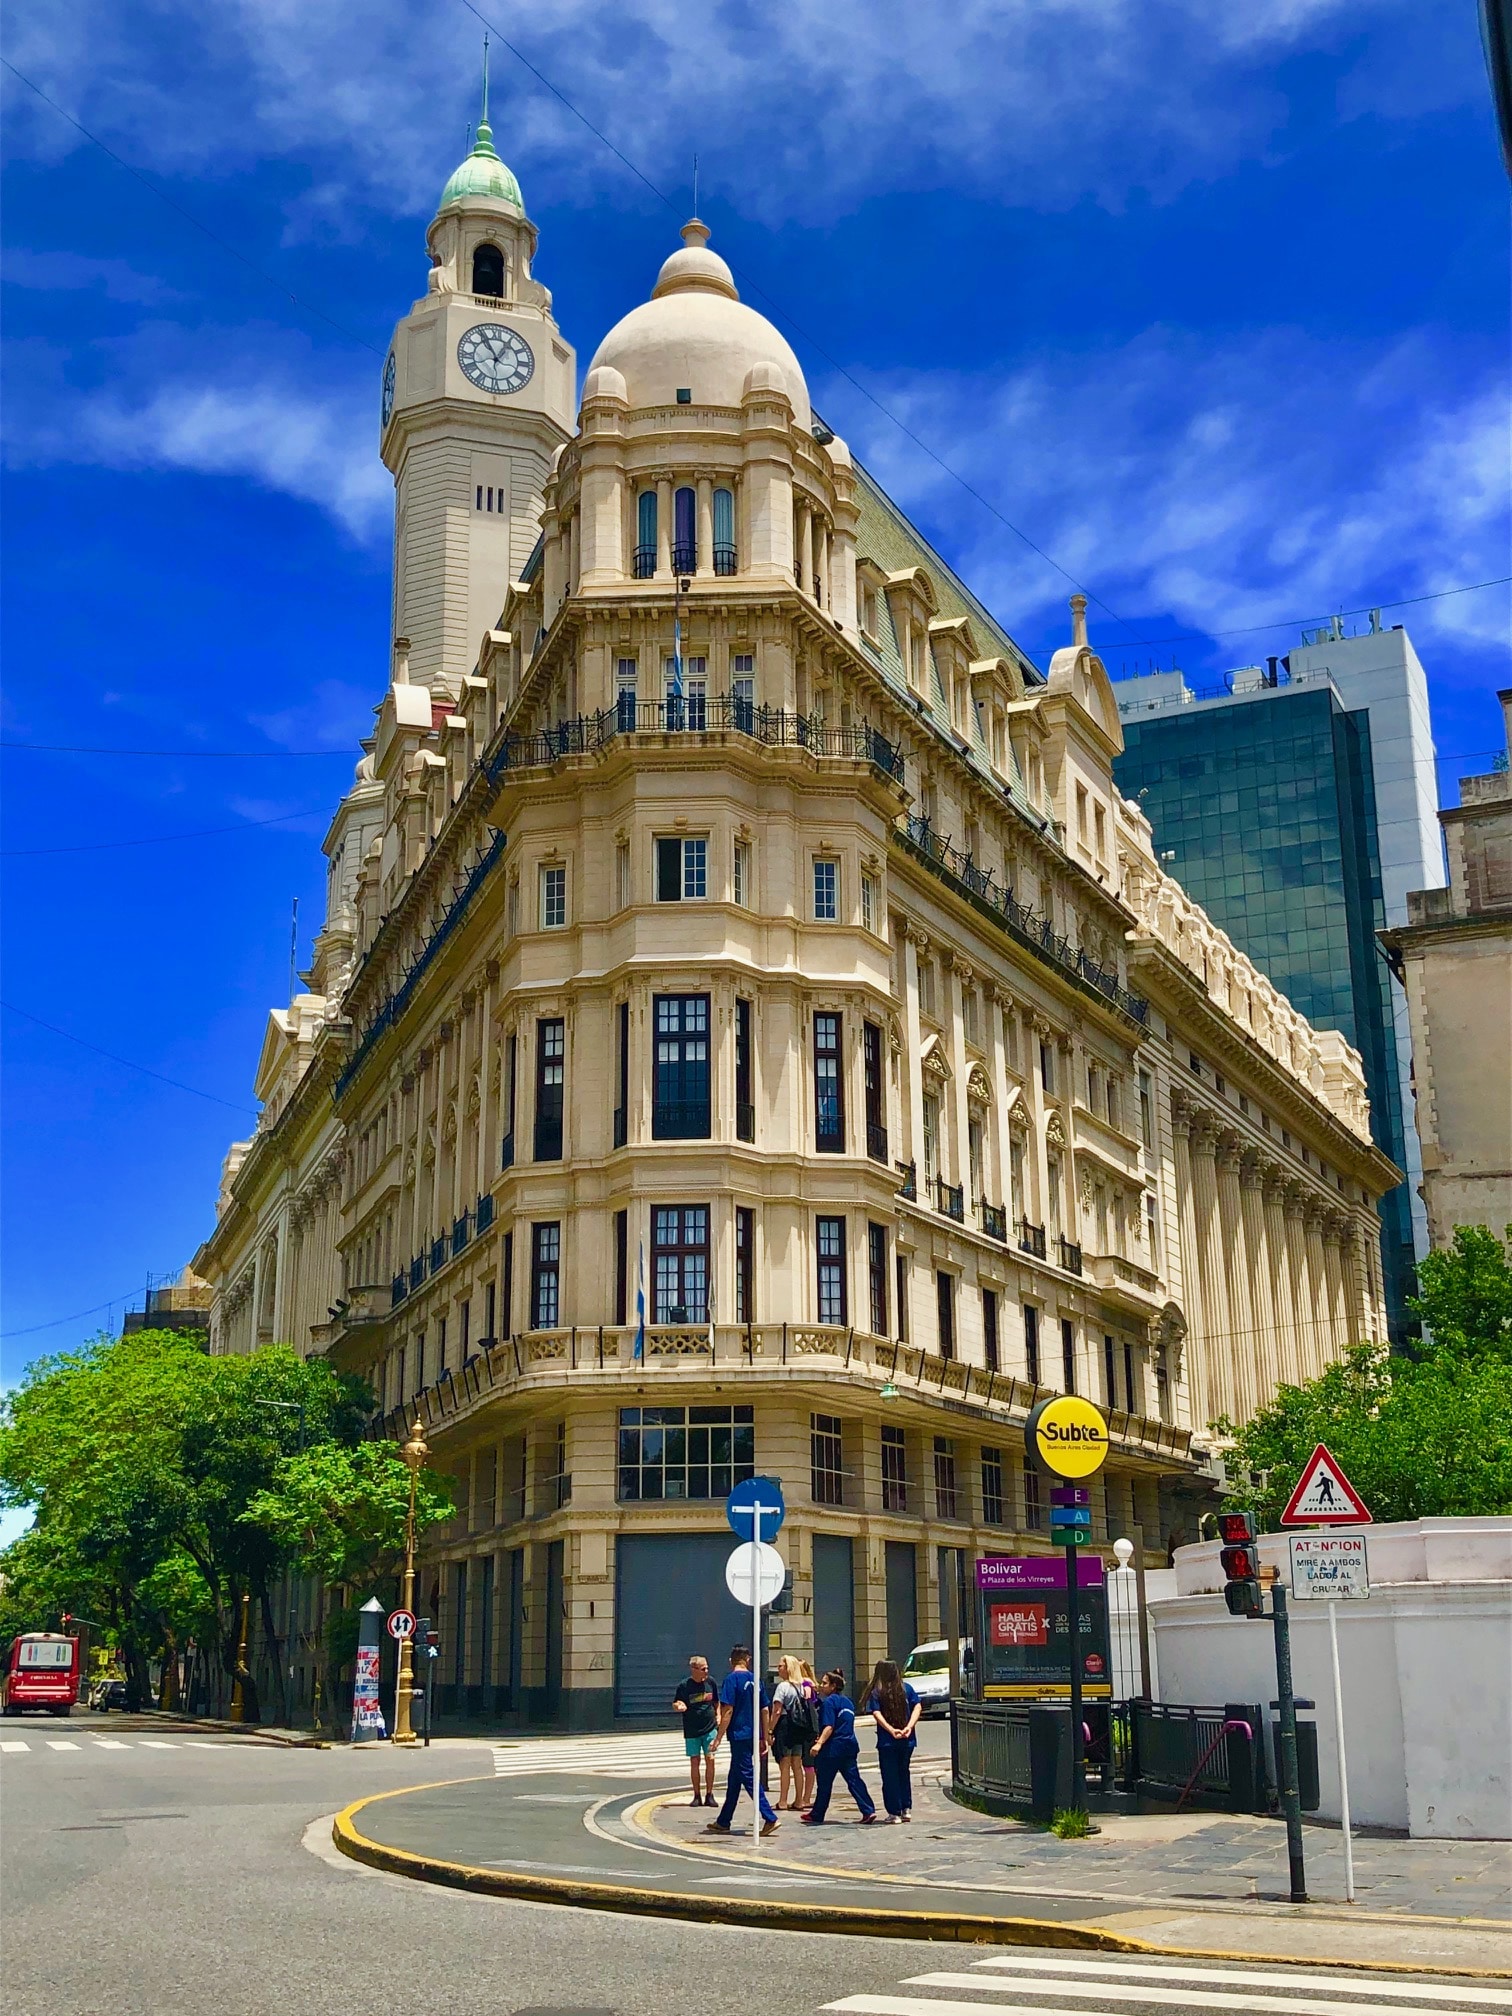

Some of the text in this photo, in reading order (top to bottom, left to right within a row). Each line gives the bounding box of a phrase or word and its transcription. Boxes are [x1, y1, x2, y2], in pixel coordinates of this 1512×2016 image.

[1045, 1421, 1102, 1442] Subte
[1074, 1489, 1082, 1502] E
[1073, 1510, 1085, 1523] A
[1074, 1530, 1084, 1543] D
[1296, 1558, 1361, 1567] MIRE A AMBOS
[980, 1562, 1022, 1575] Bolívar
[987, 1576, 1006, 1584] Plaza
[1006, 1575, 1015, 1583] de
[1016, 1575, 1027, 1583] los
[1027, 1575, 1055, 1584] Virreyes
[1307, 1571, 1352, 1580] LADOS AL
[997, 1610, 1036, 1621] HABLÁ
[1055, 1613, 1068, 1623] 30
[997, 1621, 1038, 1632] GRATIS
[1055, 1626, 1069, 1634] DES
